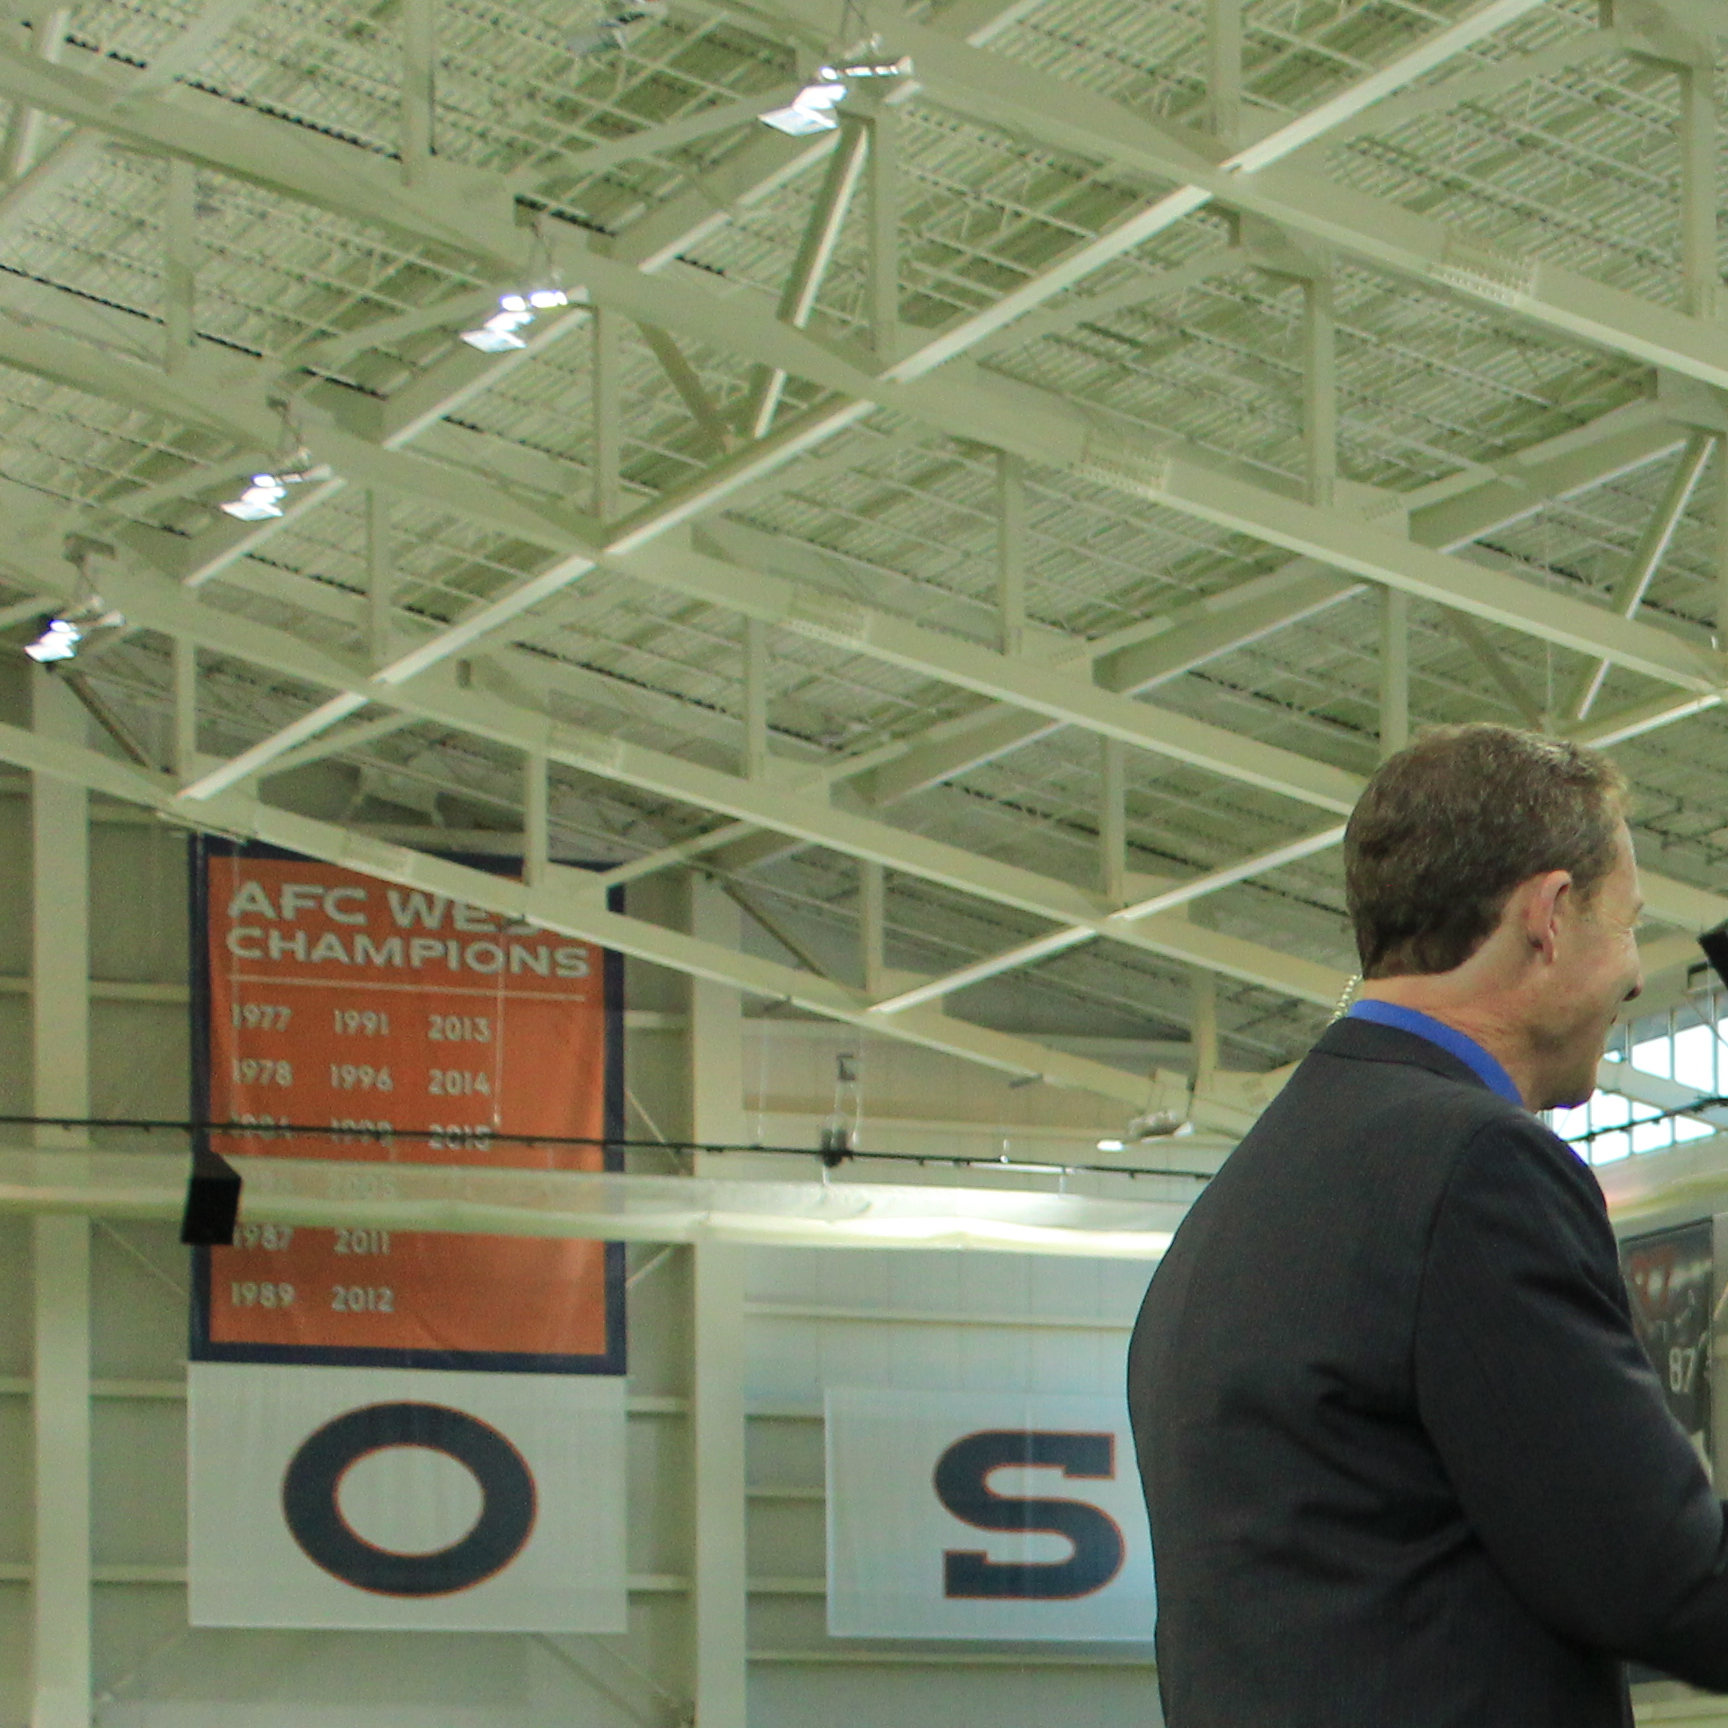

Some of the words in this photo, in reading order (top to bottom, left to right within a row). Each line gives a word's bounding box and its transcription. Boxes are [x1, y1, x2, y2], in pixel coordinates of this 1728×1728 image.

[228, 880, 368, 926] AFC
[386, 889, 578, 938] WE
[226, 926, 591, 979] CHAMPIONS
[231, 1003, 293, 1032] 1977
[333, 1009, 389, 1036] 1991
[428, 1014, 493, 1043] 2013
[231, 1056, 294, 1087] 1978
[330, 1063, 394, 1092] 1996
[428, 1069, 491, 1096] 2014
[333, 1228, 390, 1255] 2011
[230, 1281, 296, 1308] 1989
[331, 1286, 395, 1312] 2012
[1669, 1346, 1698, 1395] 87
[281, 1400, 538, 1599] O
[931, 1428, 1126, 1599] S
